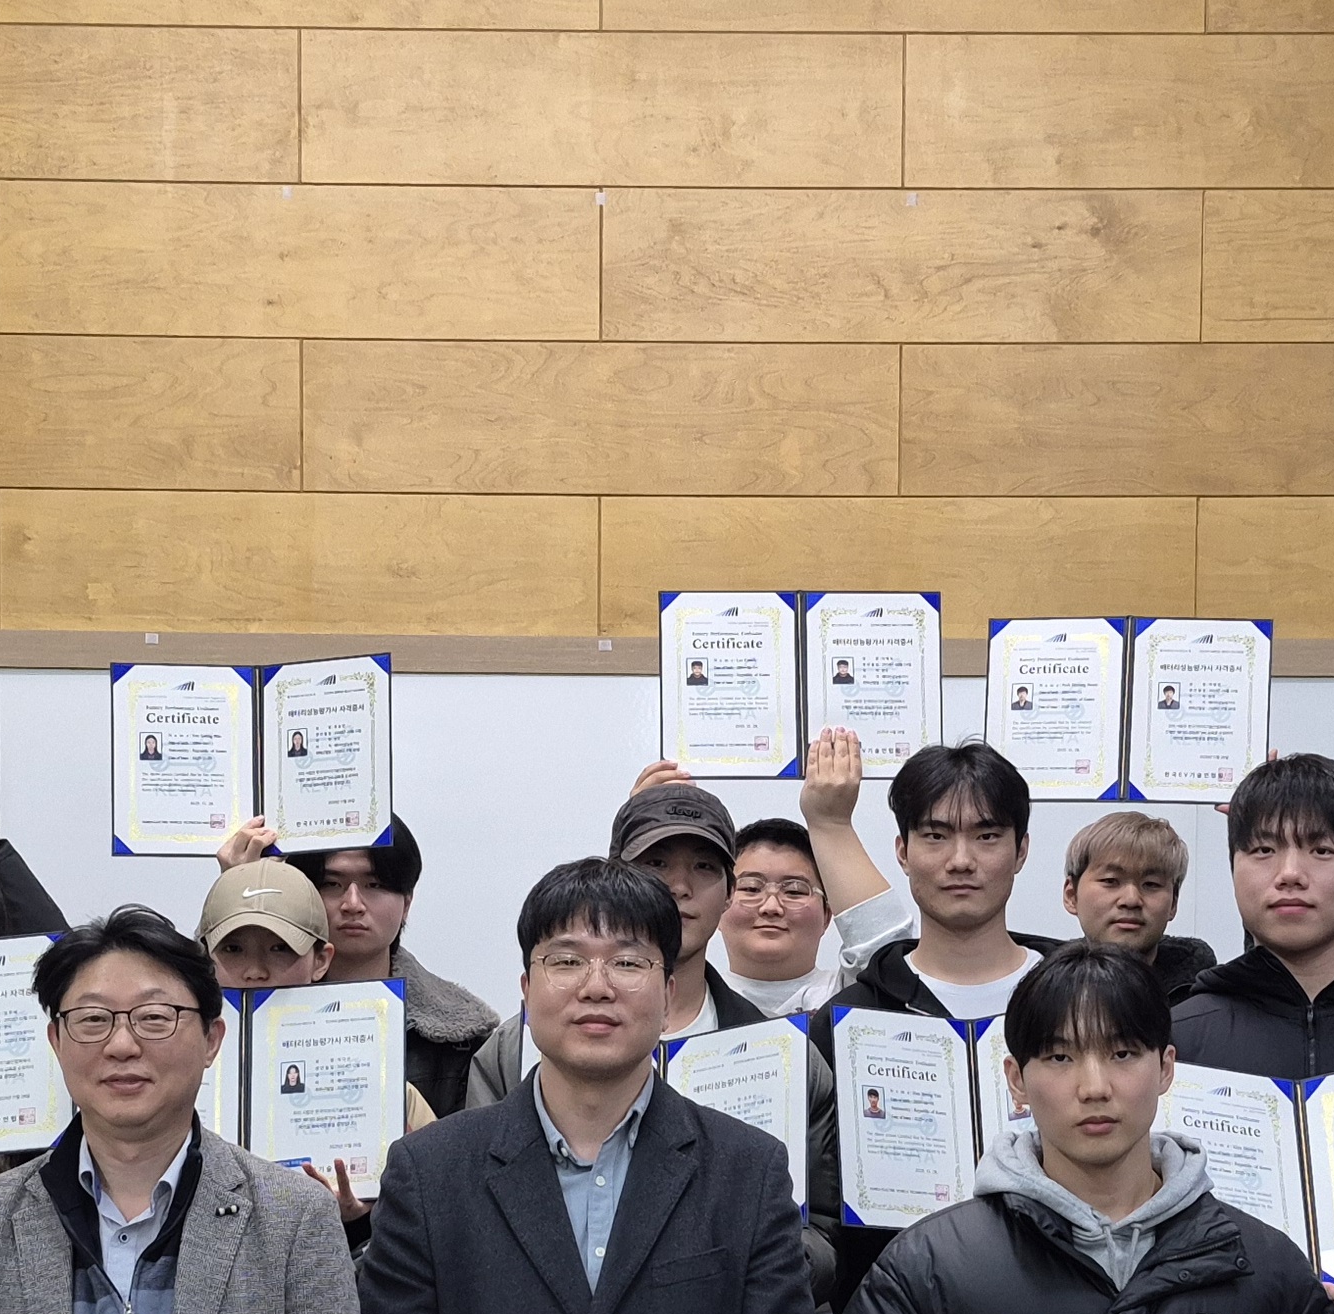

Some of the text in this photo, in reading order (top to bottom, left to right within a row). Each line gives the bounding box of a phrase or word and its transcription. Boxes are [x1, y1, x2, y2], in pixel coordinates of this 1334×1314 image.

[693, 638, 763, 649] Certificate
[1019, 663, 1089, 674] Certificate
[146, 712, 220, 724] Certificate
[10, 988, 33, 996] 자격증
[868, 1064, 937, 1081] Certificate
[1183, 1115, 1261, 1137] Certificate
